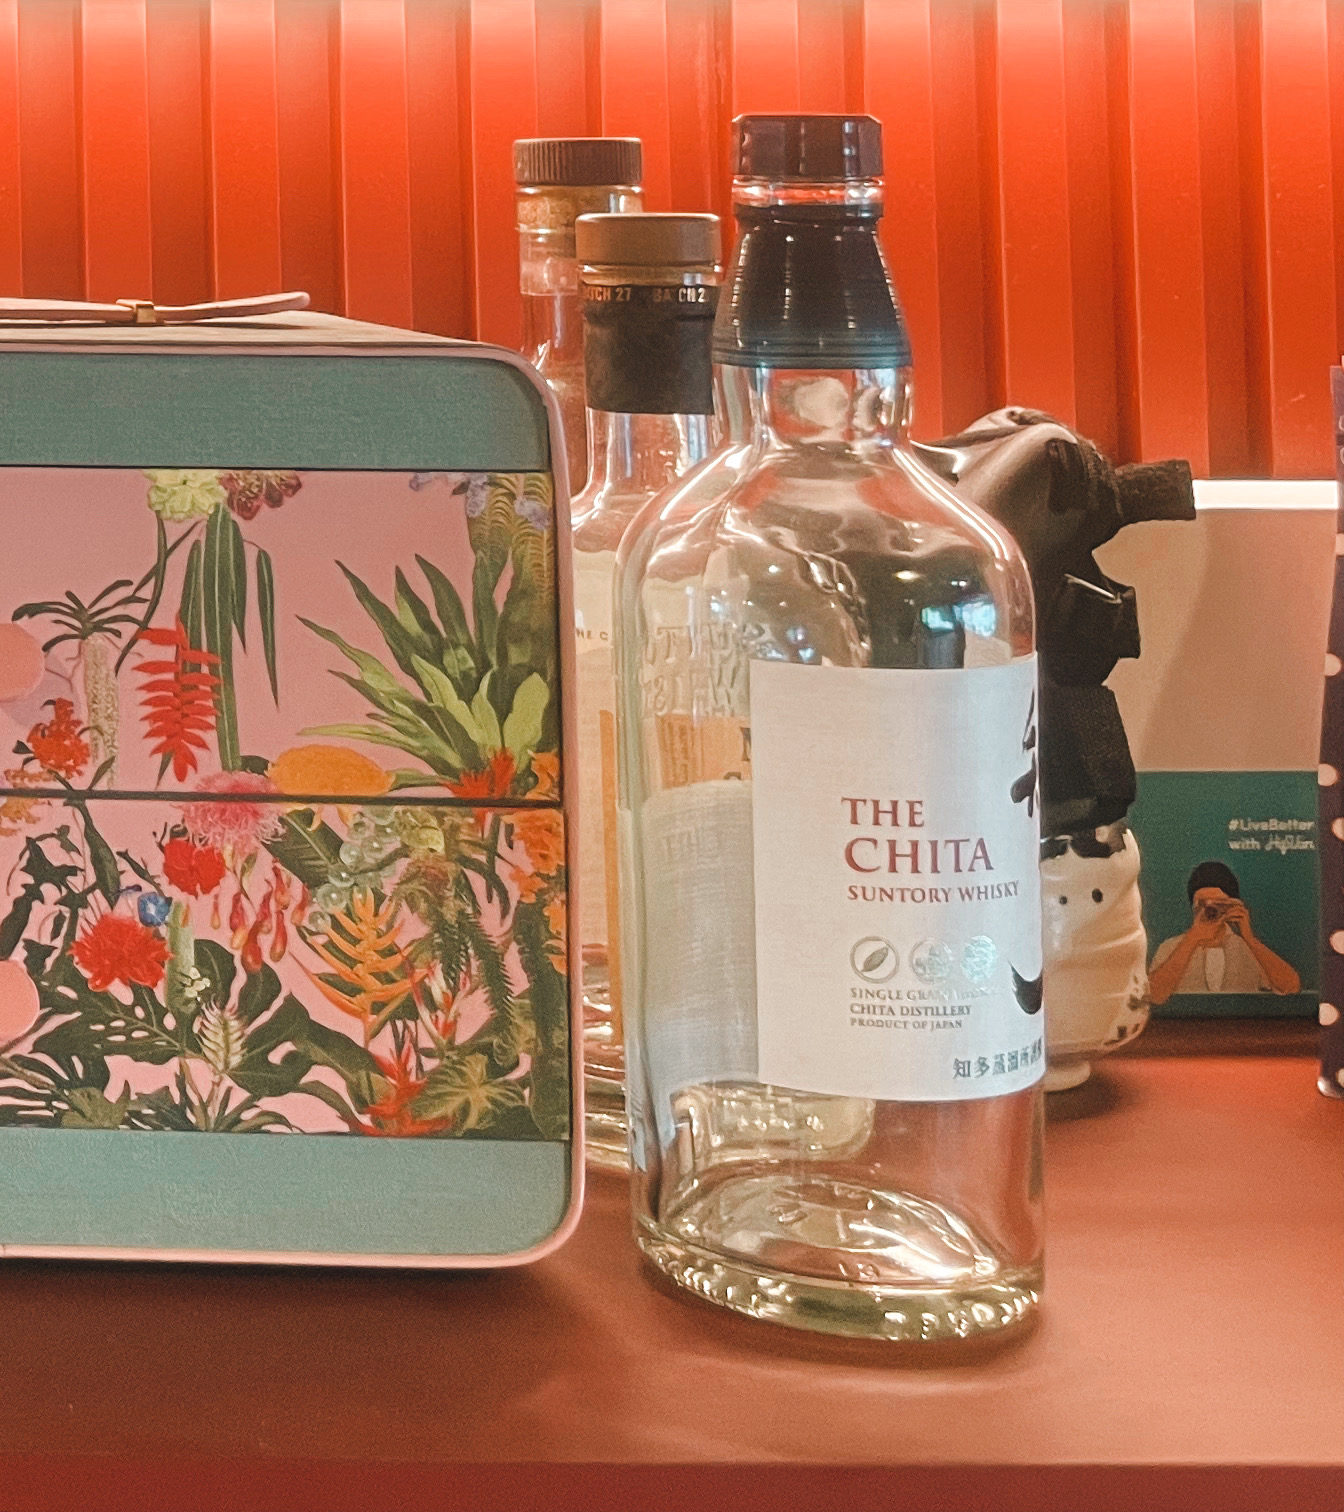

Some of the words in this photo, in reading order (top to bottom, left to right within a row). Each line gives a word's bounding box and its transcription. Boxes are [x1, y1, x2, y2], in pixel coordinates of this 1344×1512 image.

[841, 796, 925, 828] THE
[844, 836, 996, 875] CHITA
[847, 885, 952, 905] SUNTORY
[959, 880, 1020, 902] WHISKY
[849, 988, 903, 1001] SINGLE
[849, 1003, 896, 1017] CHITA
[900, 1004, 972, 1017] DISTILLERY
[849, 1017, 909, 1030] PRODUCT
[912, 1019, 928, 1030] OF
[930, 1019, 963, 1031] JAPAN
